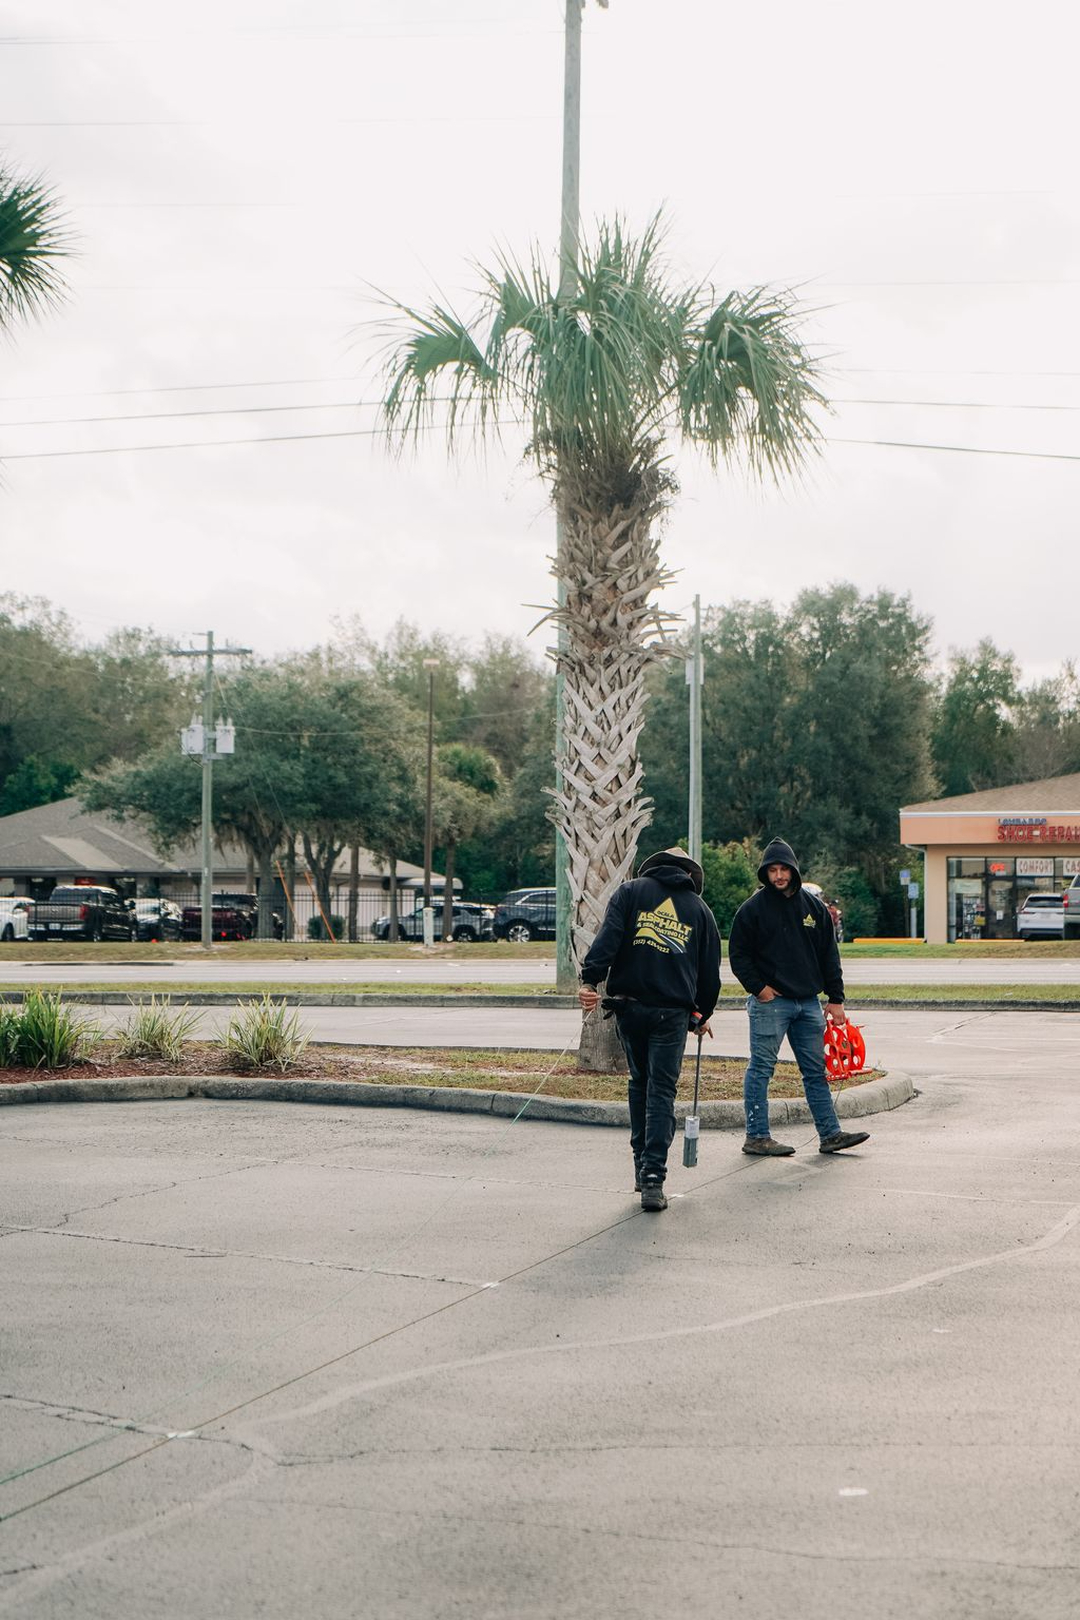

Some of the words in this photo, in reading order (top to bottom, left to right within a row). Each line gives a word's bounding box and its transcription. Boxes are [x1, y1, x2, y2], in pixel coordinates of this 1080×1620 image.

[997, 826, 1034, 842] SHOE
[1039, 826, 1080, 842] REPAI
[1019, 860, 1053, 874] COMFORT
[637, 911, 693, 936] ASPHALT
